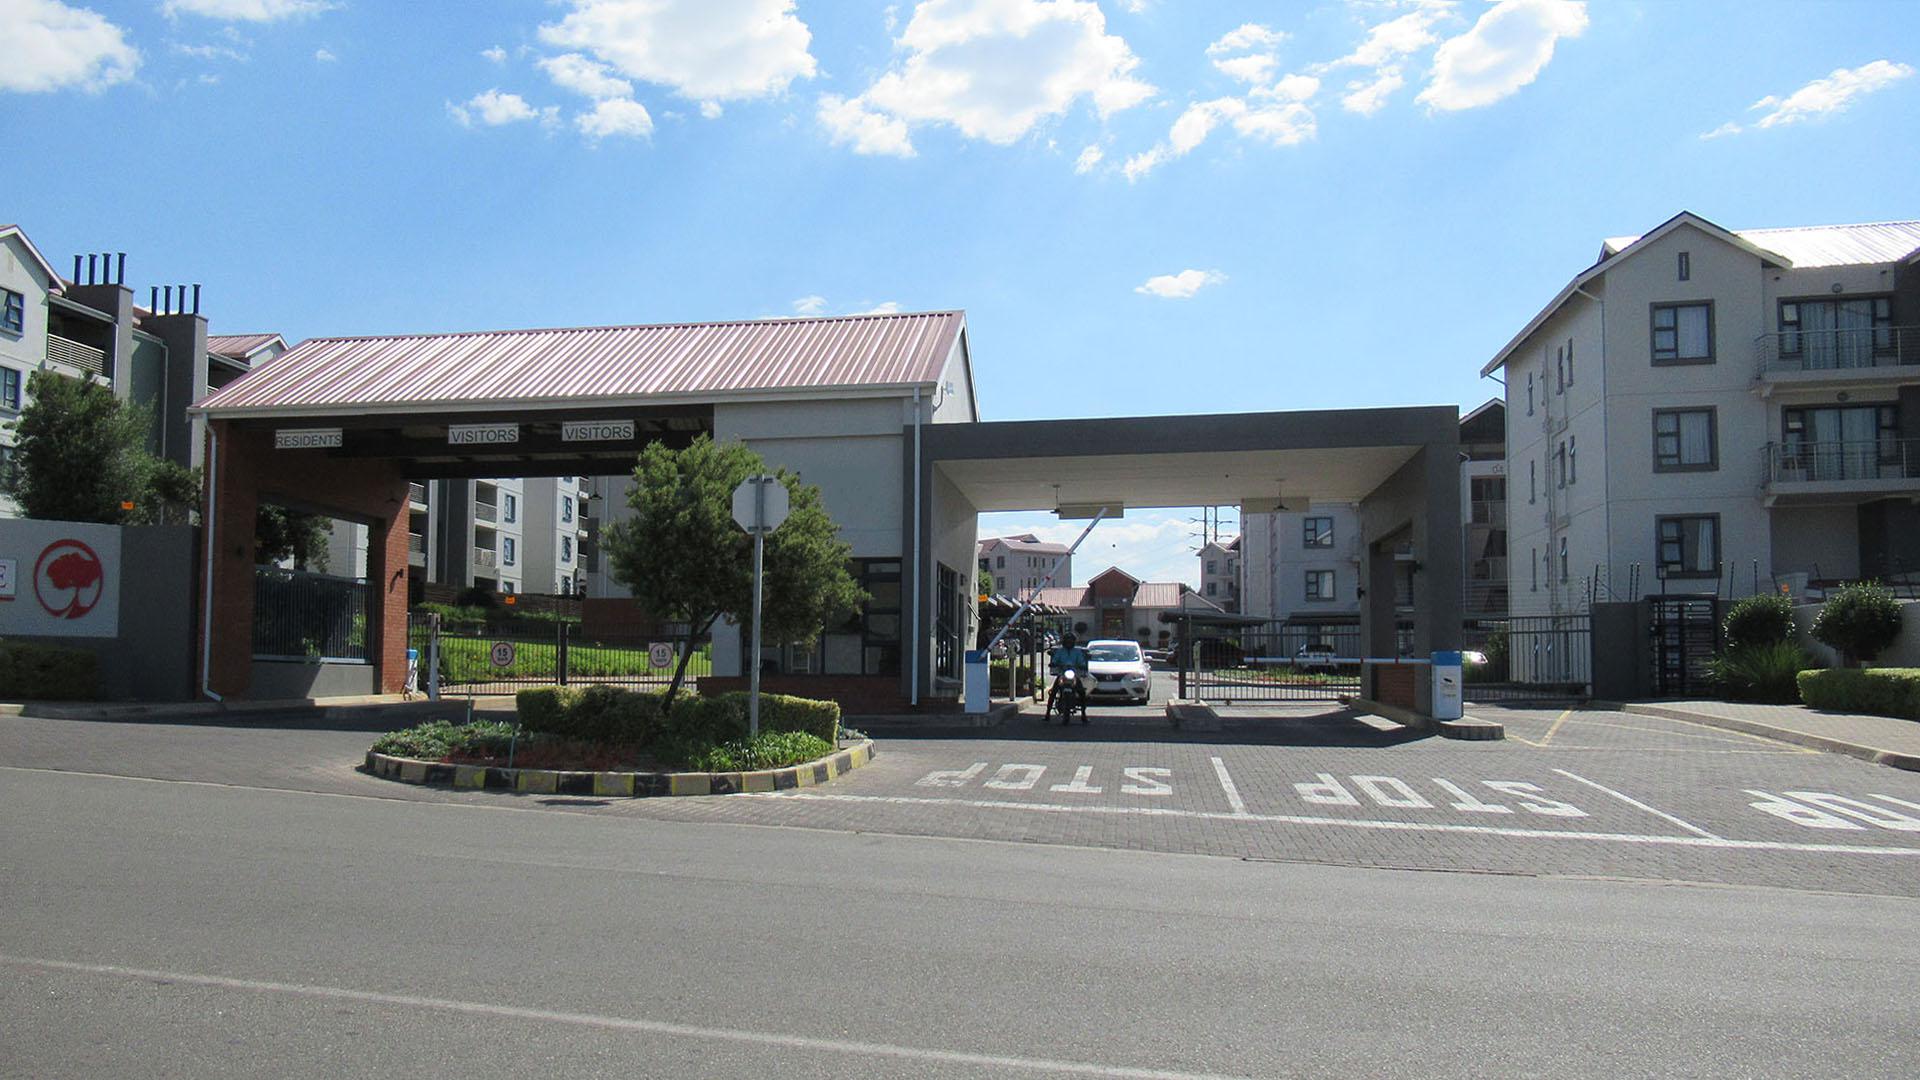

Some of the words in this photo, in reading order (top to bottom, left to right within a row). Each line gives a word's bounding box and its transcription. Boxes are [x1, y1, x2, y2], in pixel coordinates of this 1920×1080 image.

[451, 429, 518, 443] VISITORS
[565, 426, 633, 440] VISITORS
[276, 434, 343, 447] RESIDENTS
[497, 648, 508, 657] 15
[914, 762, 1173, 796] STOP
[1294, 773, 1590, 818] STOP
